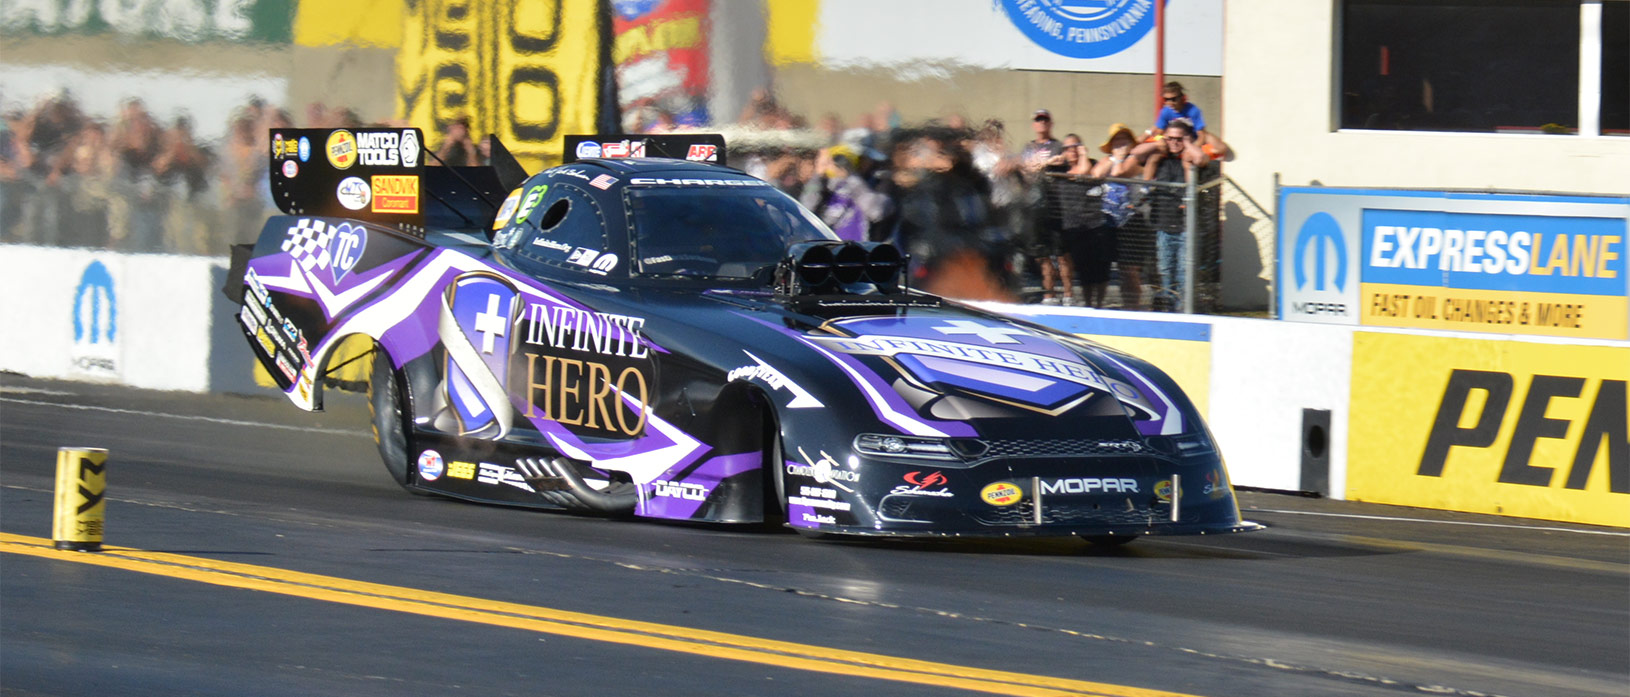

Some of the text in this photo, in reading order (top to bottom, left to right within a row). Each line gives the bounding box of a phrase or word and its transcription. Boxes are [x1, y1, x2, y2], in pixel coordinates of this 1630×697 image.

[1066, 0, 1153, 43] PENNSYLVANIA
[356, 132, 399, 149] MATCO
[358, 149, 399, 165] TOOLS
[374, 178, 416, 194] SANDVIK
[333, 231, 359, 271] TC
[1293, 302, 1347, 316] MOPAR
[1370, 293, 1585, 329] FAST OIL CHANGES & MORE
[525, 303, 649, 359] INFINITE
[835, 338, 1024, 367] INFINITE
[727, 365, 785, 391] GOODYEAR
[523, 352, 649, 436] HERO
[1415, 368, 1630, 495] PEN
[987, 484, 1020, 499] PENNZOIL
[1040, 478, 1140, 494] MOPAR
